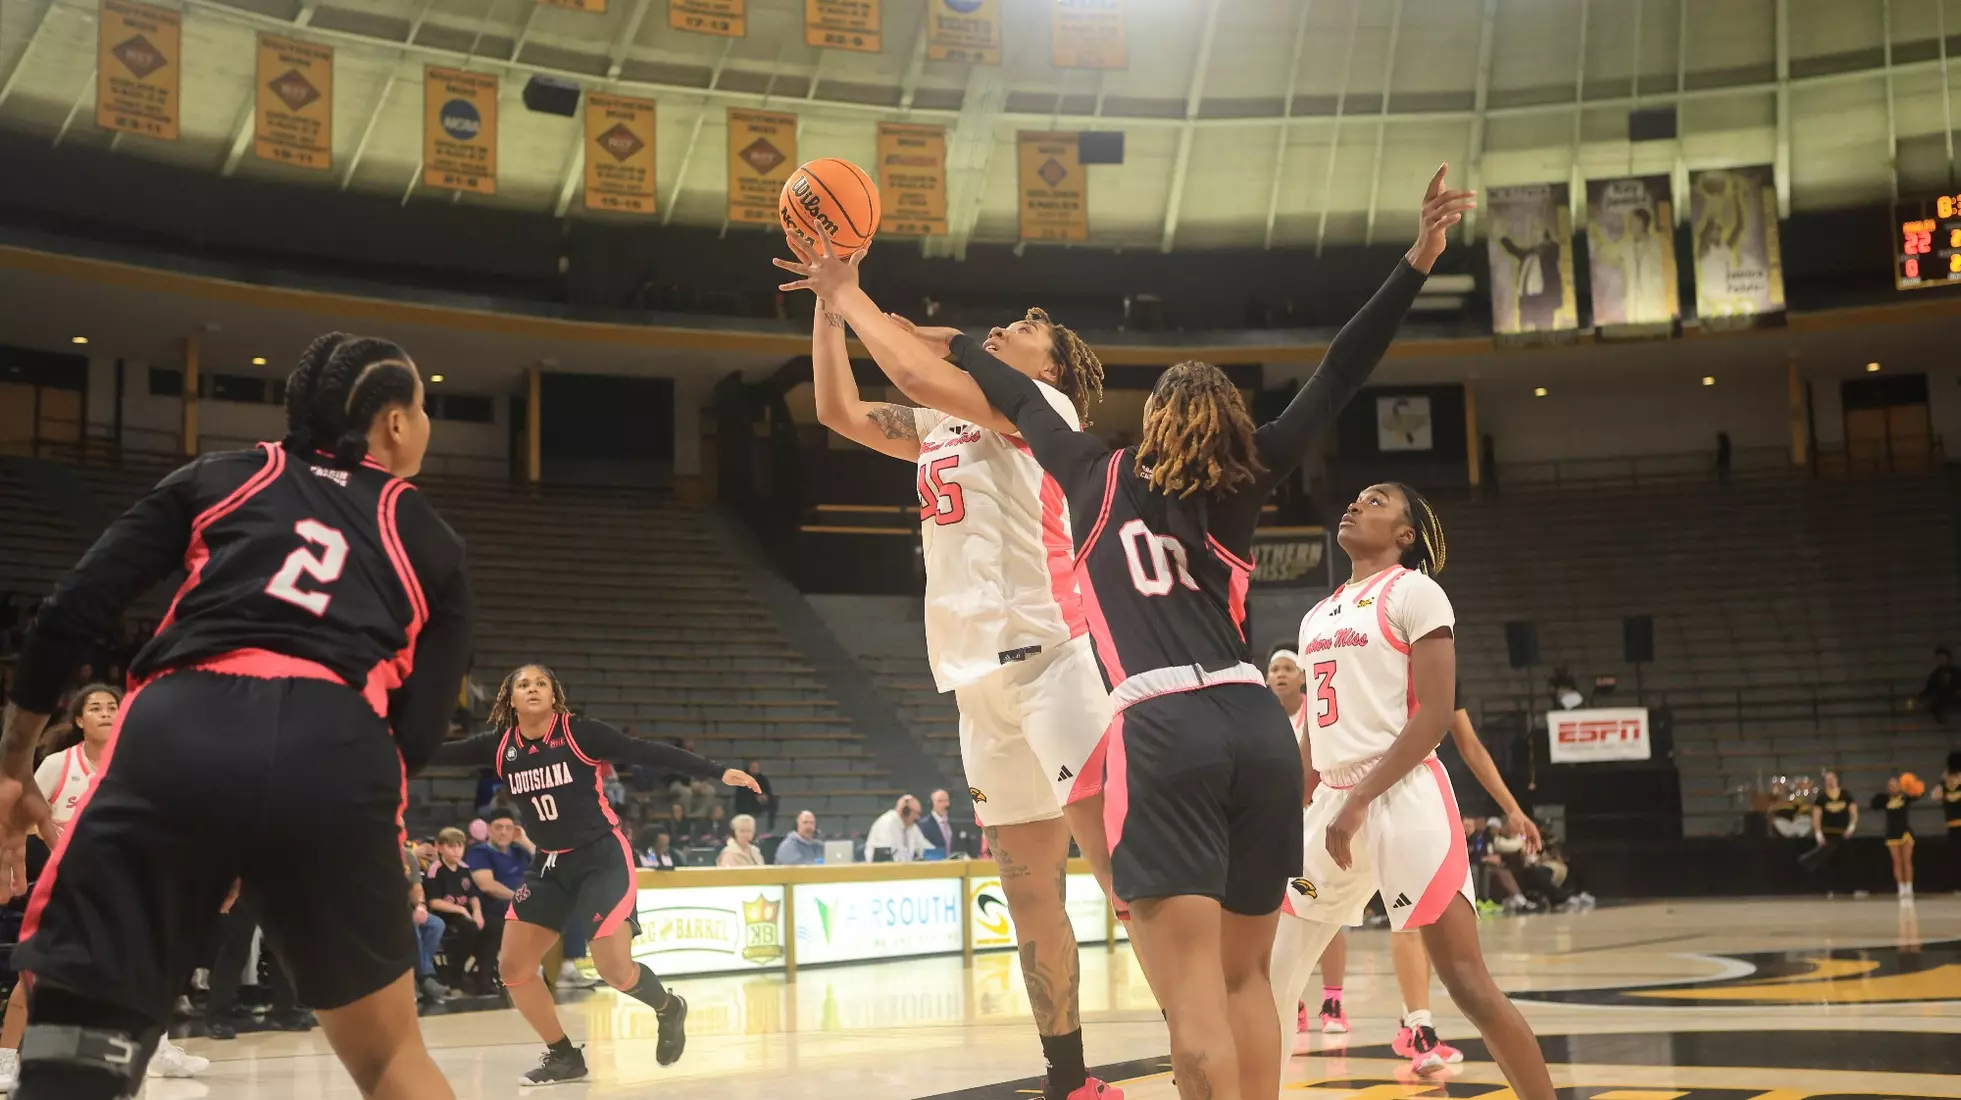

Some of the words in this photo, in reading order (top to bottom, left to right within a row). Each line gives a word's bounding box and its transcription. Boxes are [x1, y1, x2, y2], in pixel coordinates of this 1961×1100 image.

[791, 175, 839, 236] Wilson
[1904, 231, 1932, 256] 22
[264, 517, 350, 617] 2
[1251, 543, 1324, 564] THERN
[1334, 627, 1368, 648] Miss
[1313, 659, 1339, 729] 3
[1557, 718, 1640, 745] ESPN
[508, 761, 574, 795] LOUISIANA
[530, 793, 559, 822] 10
[847, 893, 957, 927] ARSOUTH
[675, 917, 730, 942] BARREL
